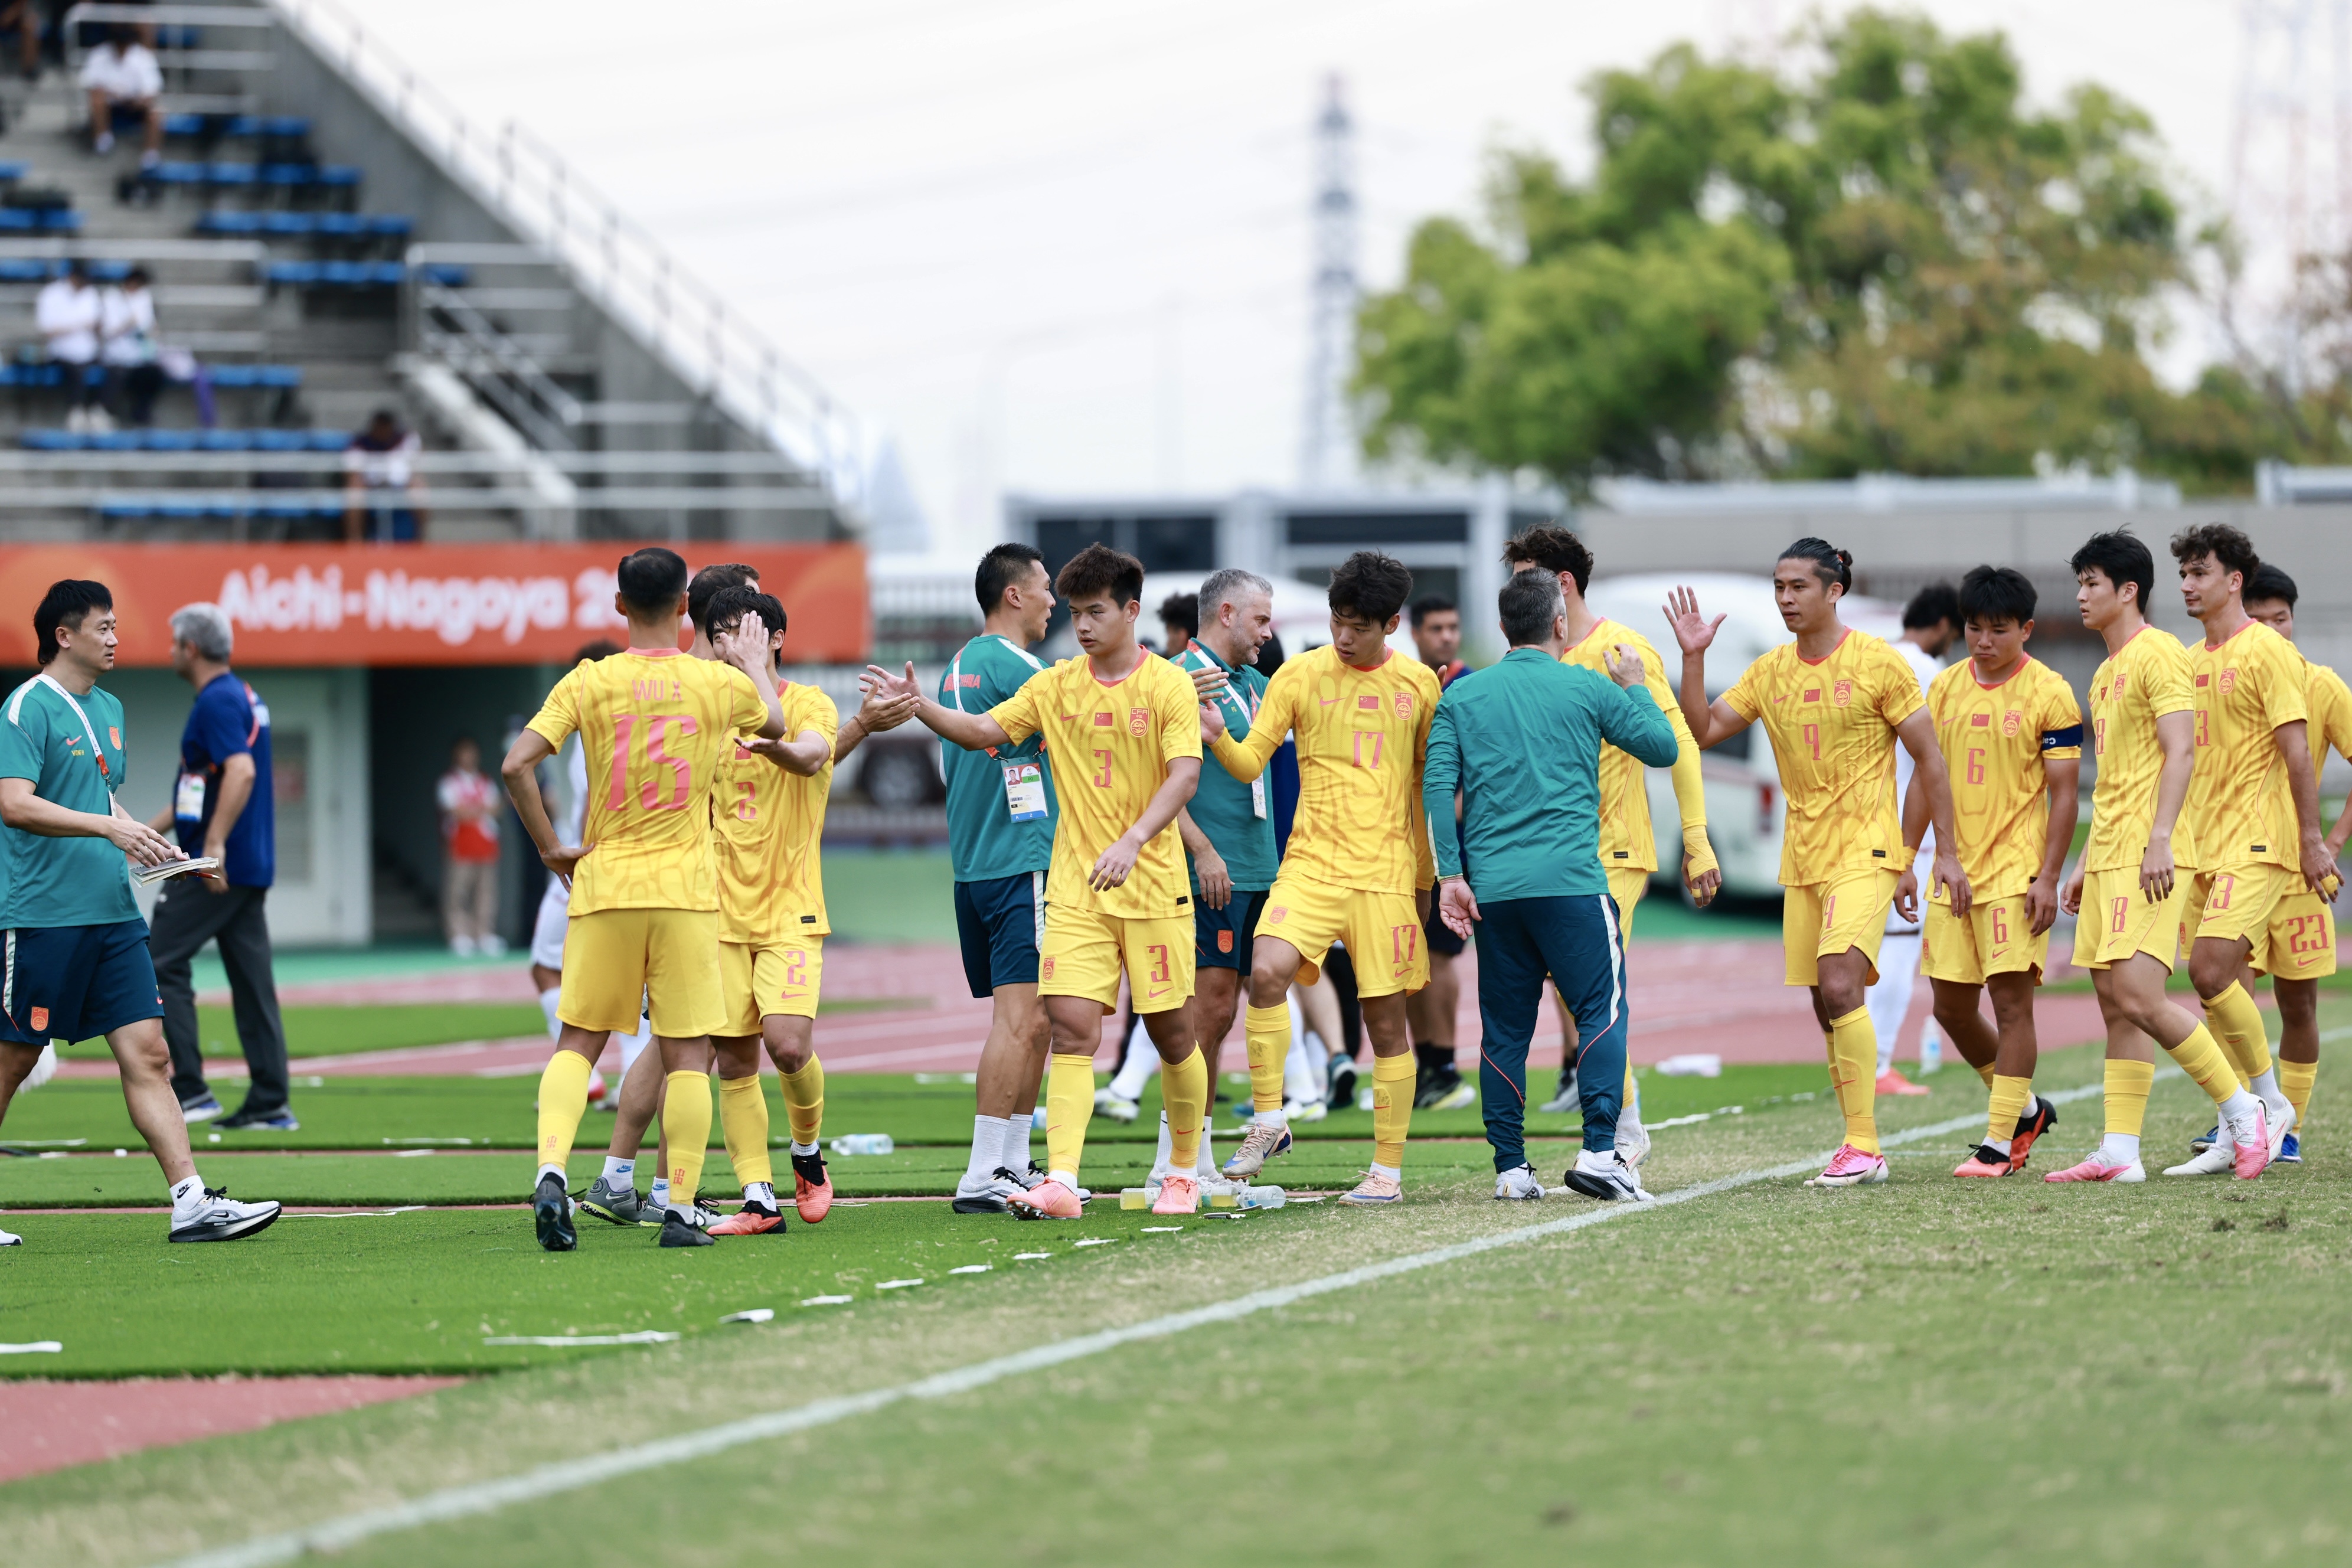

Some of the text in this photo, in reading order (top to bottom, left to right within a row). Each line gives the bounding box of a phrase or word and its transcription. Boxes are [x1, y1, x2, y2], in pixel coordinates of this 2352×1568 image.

[217, 563, 570, 645] Aichi-Nagoya
[632, 680, 683, 701] WU X
[1802, 724, 1822, 760] 9
[2096, 718, 2105, 755] 8
[2196, 710, 2210, 747] 3
[605, 714, 697, 812] 15
[1092, 749, 1113, 788] 3
[1352, 731, 1384, 769] 17
[1967, 748, 1985, 785] 6
[736, 781, 757, 819] 2
[1824, 895, 1836, 929] 9
[1991, 907, 2009, 944] 6
[1390, 924, 1417, 963] 17
[2285, 913, 2330, 953] 23
[784, 950, 808, 987] 2
[1146, 945, 1171, 983] 3
[178, 1183, 190, 1194] NIKE
